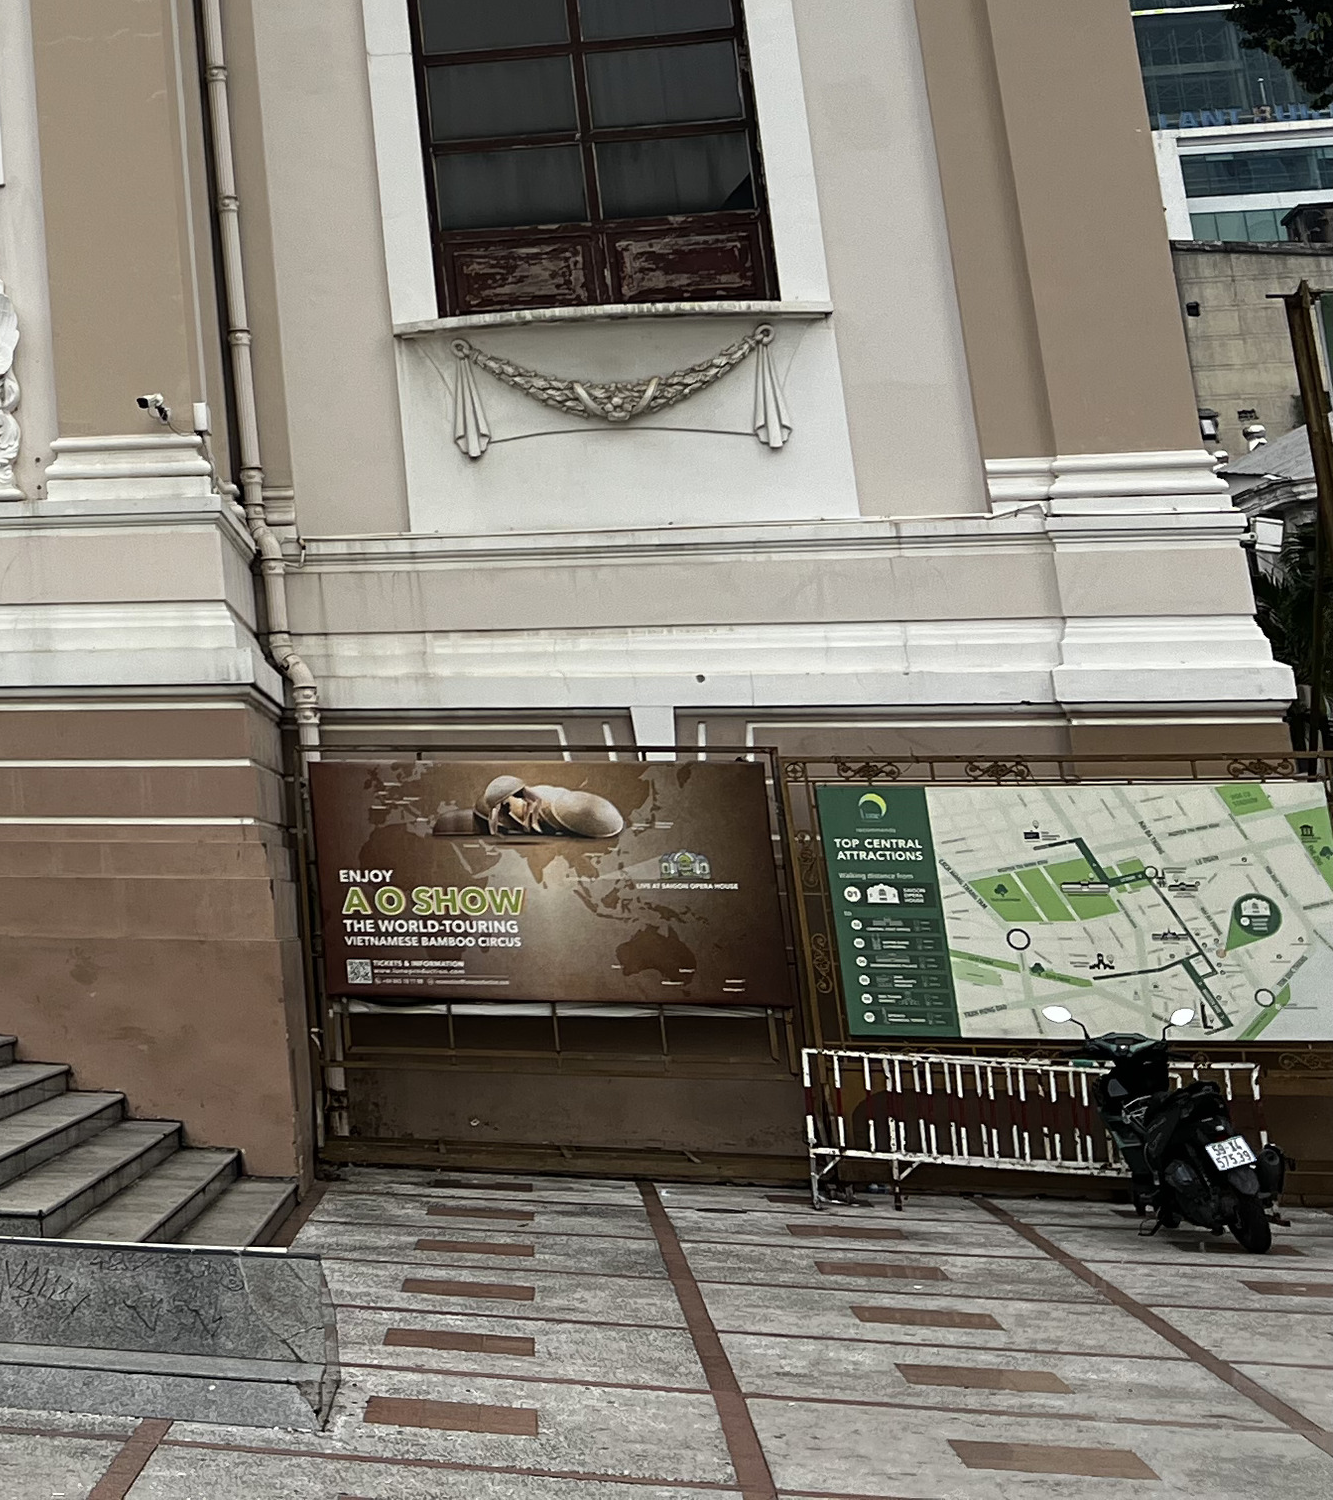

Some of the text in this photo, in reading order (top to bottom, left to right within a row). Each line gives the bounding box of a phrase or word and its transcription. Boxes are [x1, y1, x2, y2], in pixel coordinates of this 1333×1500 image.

[834, 839, 923, 848] TOP CENTRAL
[837, 851, 923, 860] ATTRACTIONS
[339, 869, 394, 882] ENJOY
[342, 886, 525, 915] A O SHOW
[343, 920, 519, 933] THE WORLD-TOURING
[344, 936, 522, 947] VIETNAMESE BAMBOO CIRCUS
